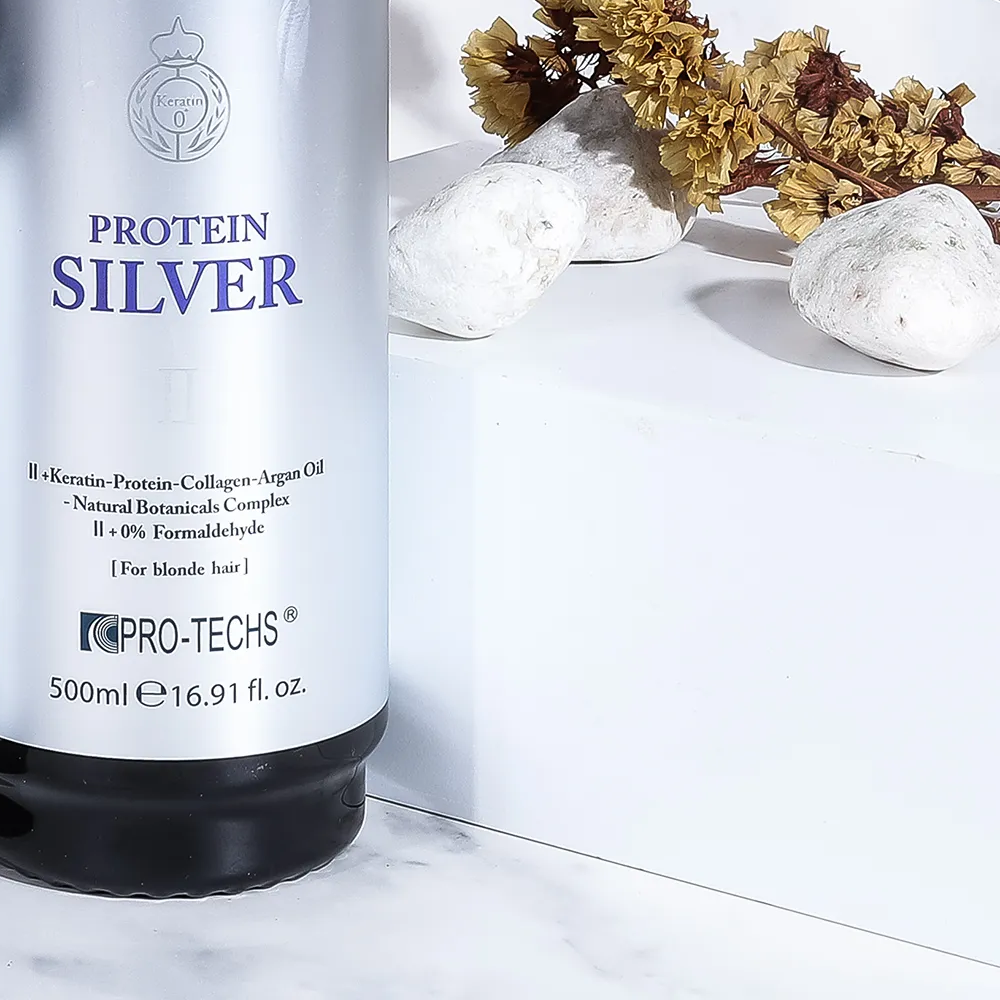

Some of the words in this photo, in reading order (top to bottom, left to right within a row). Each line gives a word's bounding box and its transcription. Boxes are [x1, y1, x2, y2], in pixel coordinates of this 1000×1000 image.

[156, 94, 203, 107] Keratin
[89, 212, 269, 245] PROTEIN
[53, 254, 303, 315] SILVER
[303, 459, 325, 477] Oil
[136, 499, 220, 515] Botanicals
[224, 494, 289, 514] Complex
[153, 521, 265, 540] Formaldehyde
[153, 562, 205, 576] blonde
[49, 677, 128, 706] 500ml
[171, 682, 237, 707] 16.91
[248, 678, 269, 701] fl.
[275, 677, 306, 698] oz.
